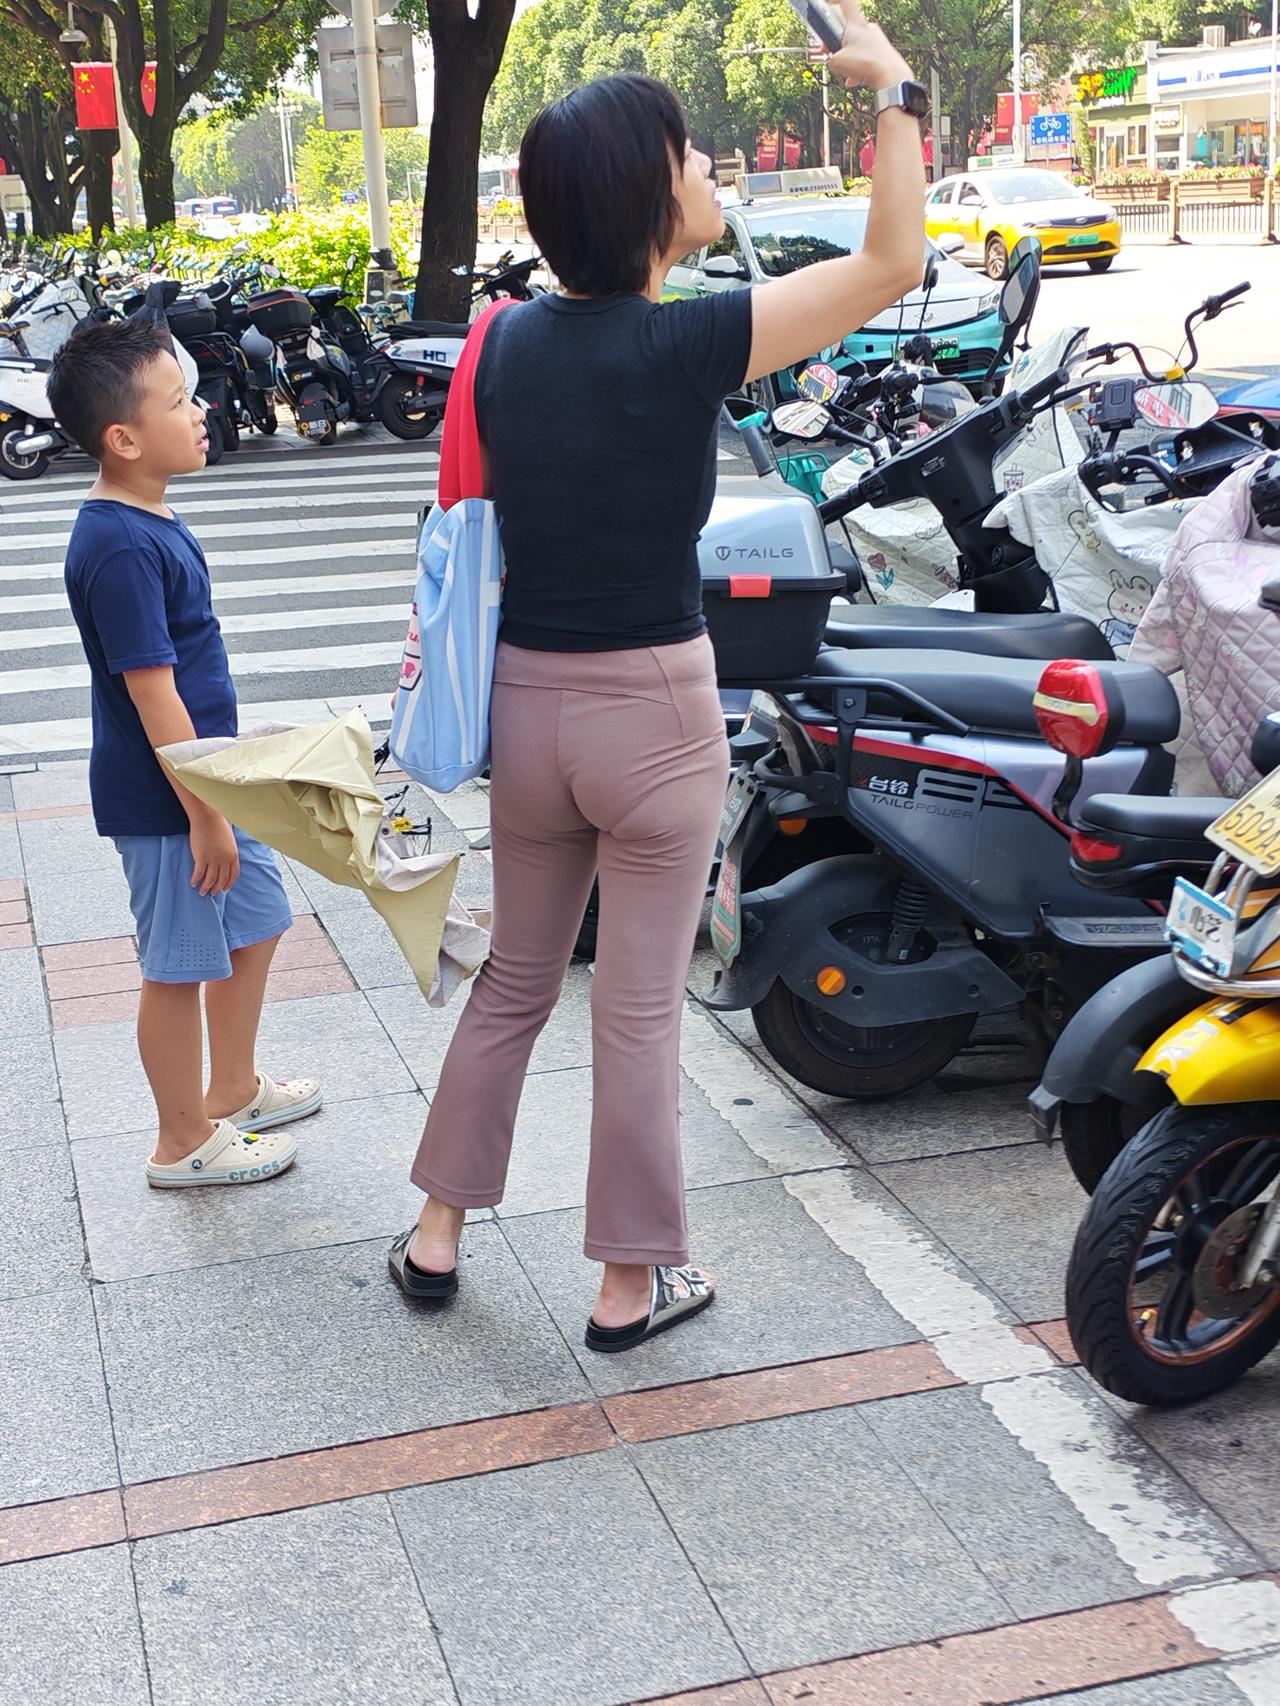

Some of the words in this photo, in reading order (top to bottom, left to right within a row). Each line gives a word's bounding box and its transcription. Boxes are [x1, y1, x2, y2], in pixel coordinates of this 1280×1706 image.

[735, 547, 794, 559] TAILG
[868, 776, 910, 795] 台铃
[228, 1160, 281, 1182] crocs
